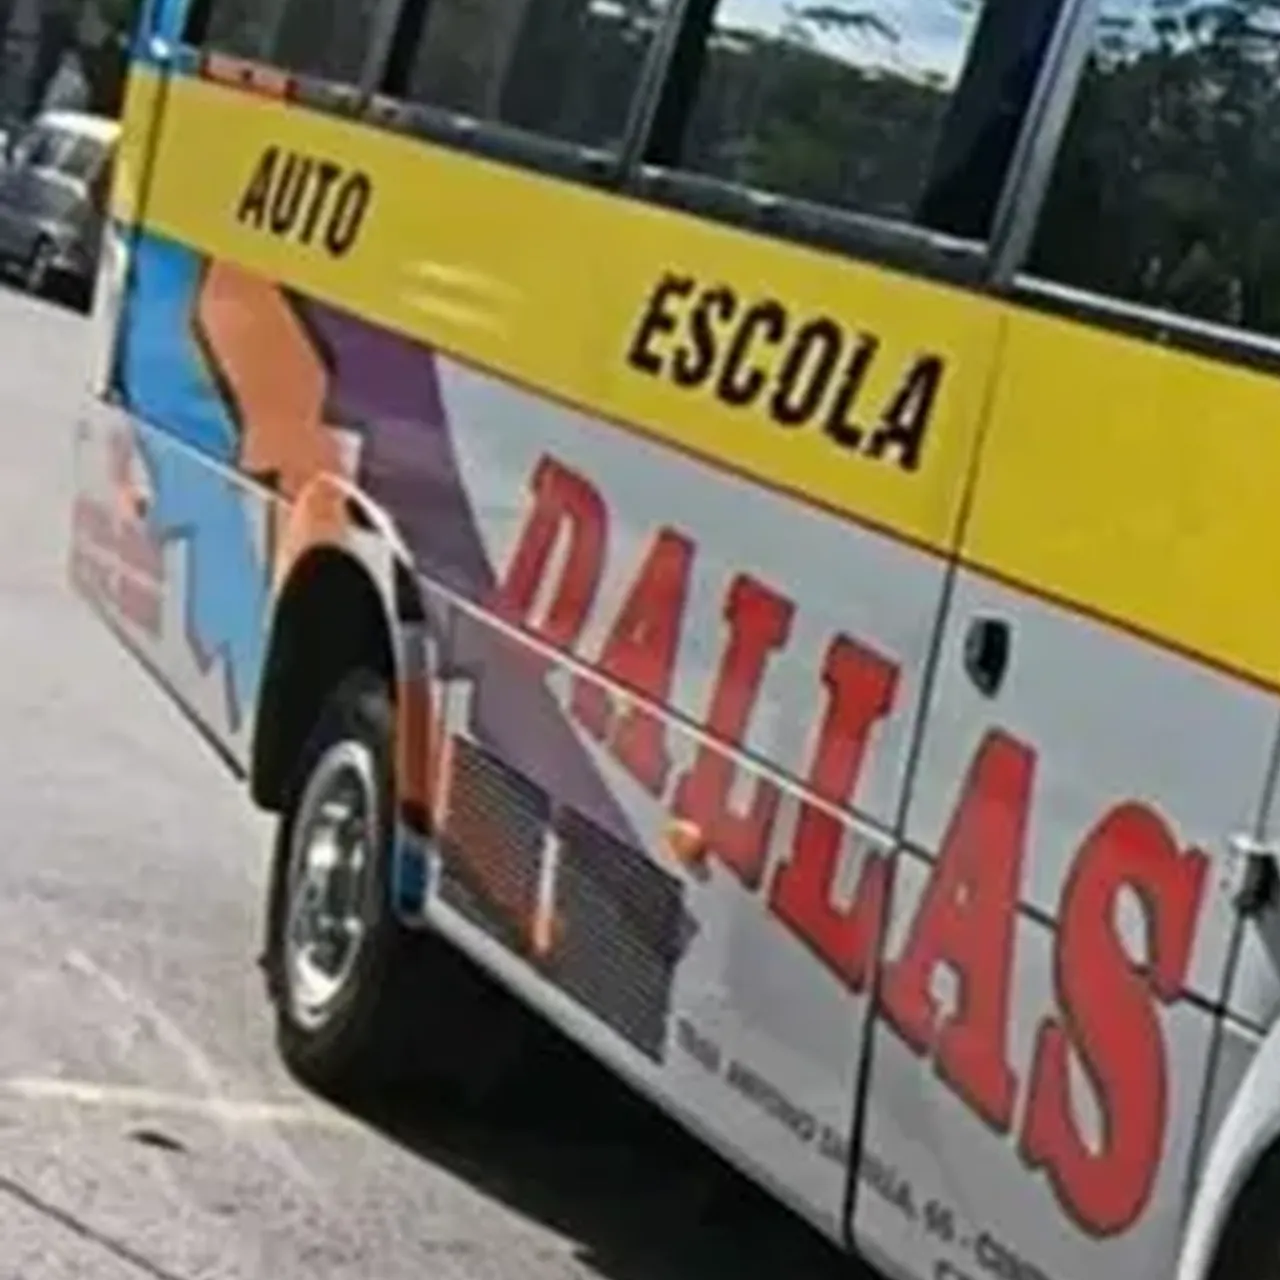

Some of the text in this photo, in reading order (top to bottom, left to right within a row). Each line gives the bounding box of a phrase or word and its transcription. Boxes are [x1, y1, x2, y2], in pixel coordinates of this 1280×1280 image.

[236, 145, 947, 472] AUTO ESCOLA
[494, 453, 1210, 1238] DALLAS
